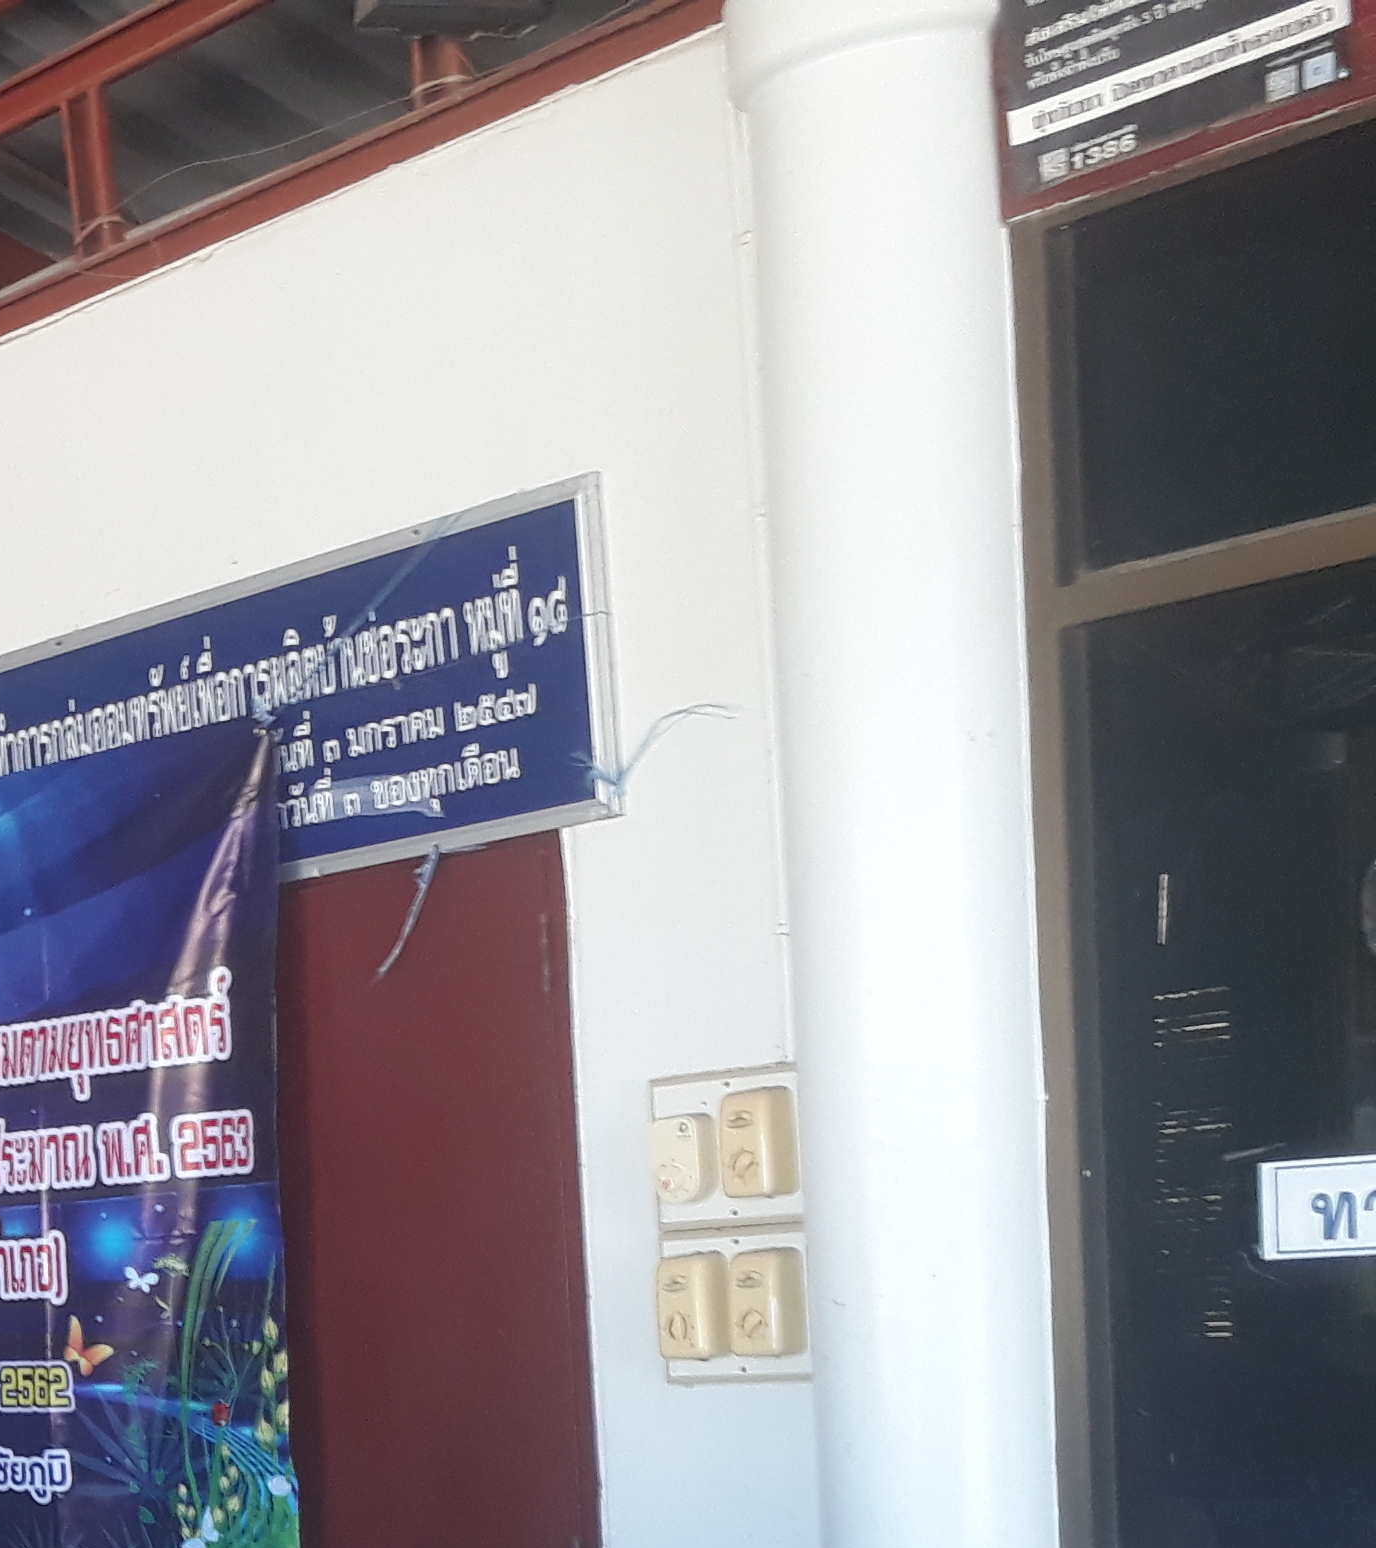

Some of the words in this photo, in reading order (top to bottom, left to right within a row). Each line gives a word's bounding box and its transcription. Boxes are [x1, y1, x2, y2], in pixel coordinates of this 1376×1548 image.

[462, 545, 524, 679] หมู่ที่
[322, 738, 342, 764] ๓
[345, 706, 446, 758] มกราคม
[452, 683, 538, 733] ๒๕๔๗
[343, 791, 362, 817] ๓
[369, 742, 522, 814] ของทุกเดือน
[97, 1112, 170, 1184] พ.ศ.
[171, 1109, 253, 1178] 2563
